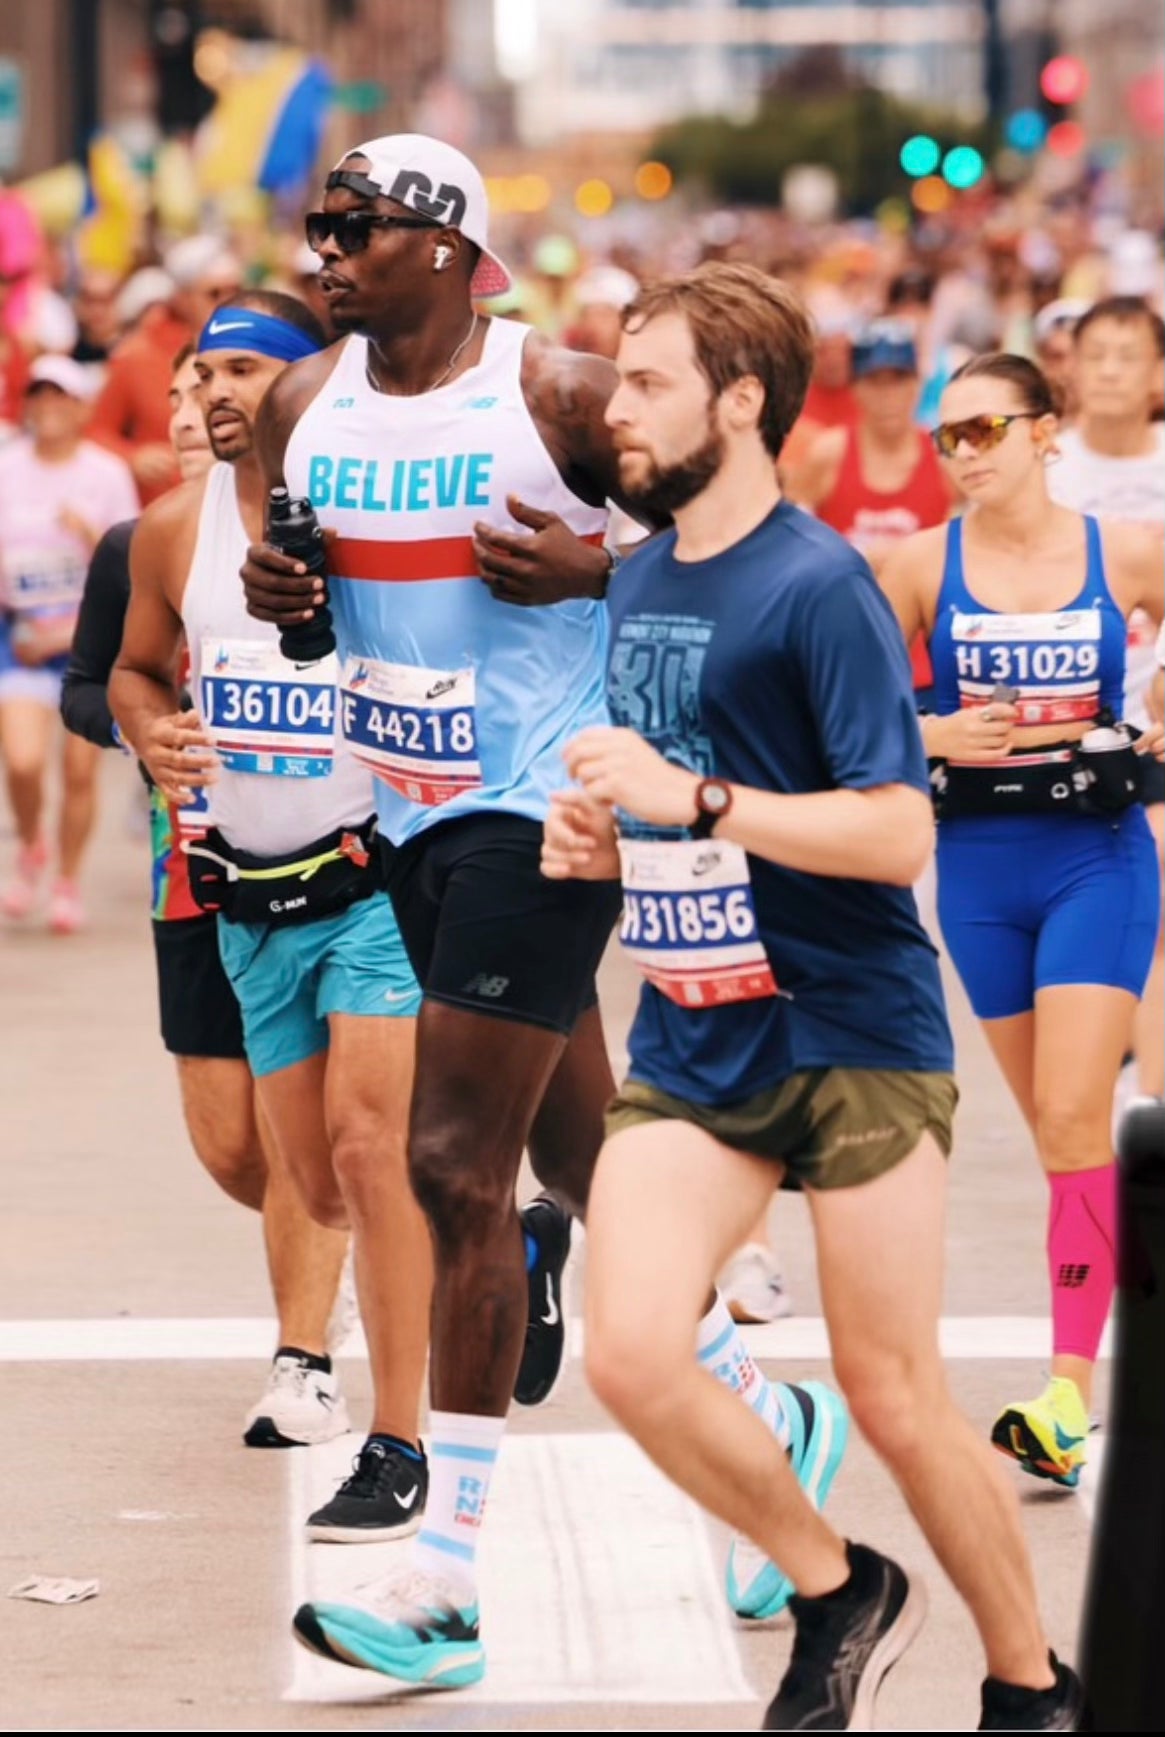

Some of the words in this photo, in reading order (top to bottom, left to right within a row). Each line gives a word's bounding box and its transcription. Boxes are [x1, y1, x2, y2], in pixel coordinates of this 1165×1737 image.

[309, 454, 493, 512] BELIEVE
[957, 646, 981, 678] H
[990, 645, 1098, 680] 31029
[222, 682, 334, 727] 36104
[343, 697, 358, 734] F
[367, 706, 475, 753] 44218
